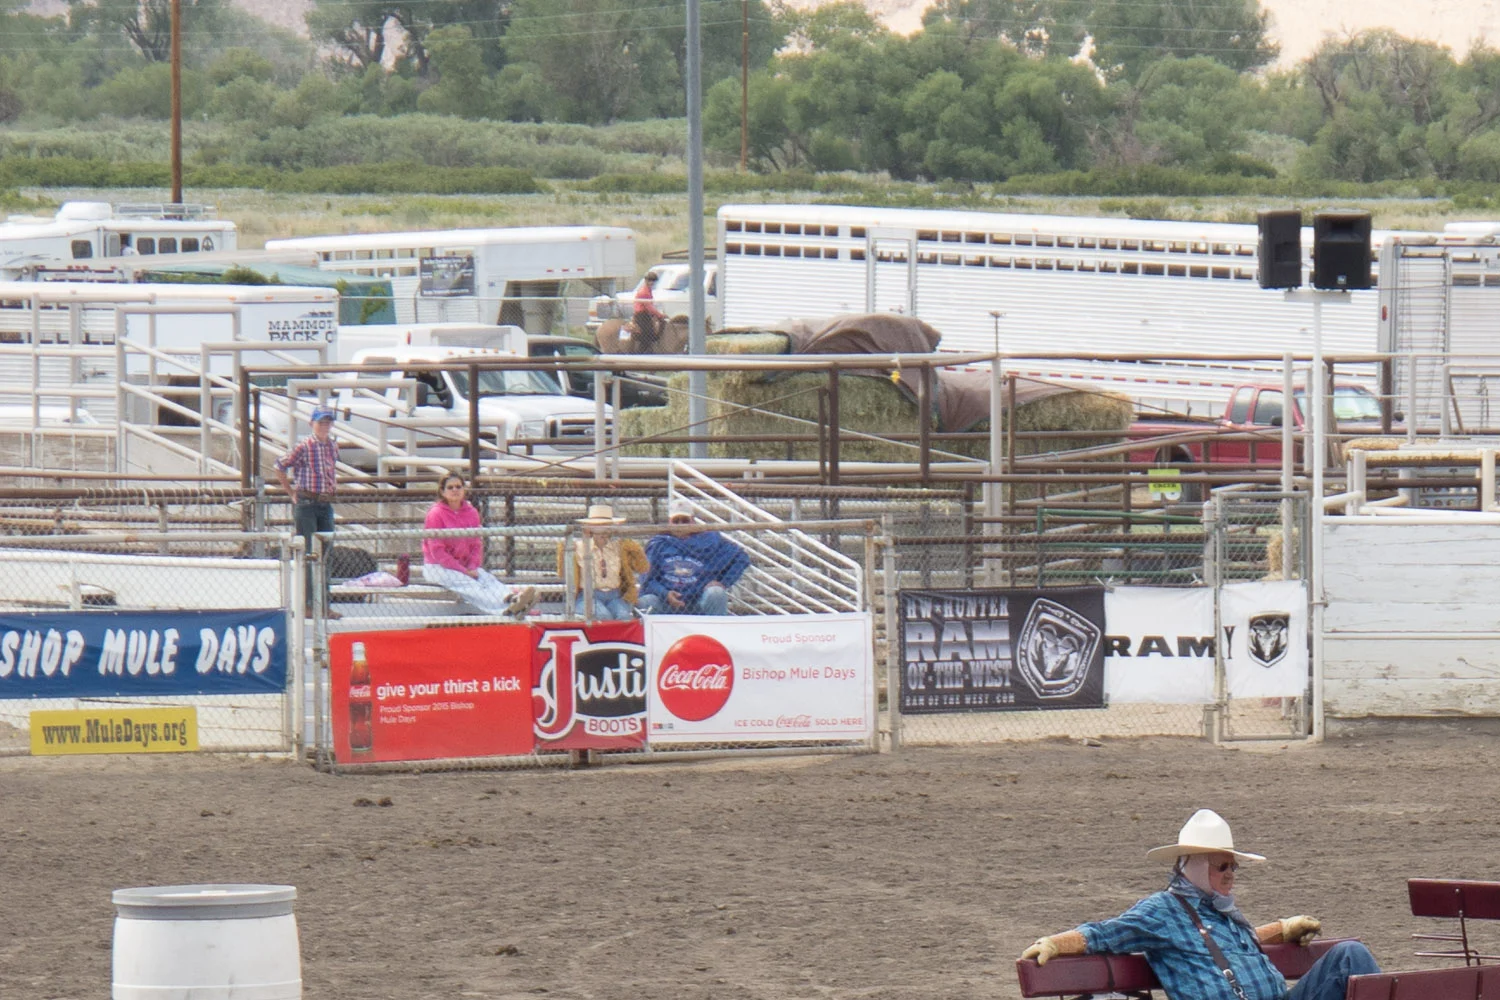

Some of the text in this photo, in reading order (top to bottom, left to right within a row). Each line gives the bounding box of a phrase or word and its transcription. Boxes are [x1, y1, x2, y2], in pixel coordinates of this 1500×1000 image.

[268, 320, 333, 330] MAMMOT
[761, 633, 837, 645] Proud Sponsor
[905, 620, 1011, 662] RAM
[1103, 635, 1216, 658] RAM
[0, 625, 276, 678] SHOP MULE DAYS
[742, 666, 856, 680] Bishop Mule Days
[933, 662, 964, 689] THE
[969, 660, 1013, 688] WEST
[376, 676, 521, 700] give your thirst a kick
[533, 630, 647, 740] Justi
[41, 718, 187, 746] www.MuleDays.org
[588, 717, 639, 732] BOOTS
[734, 719, 748, 727] ICE
[750, 719, 774, 727] COLD
[815, 718, 838, 726] SOLD
[841, 717, 863, 726] HERE
